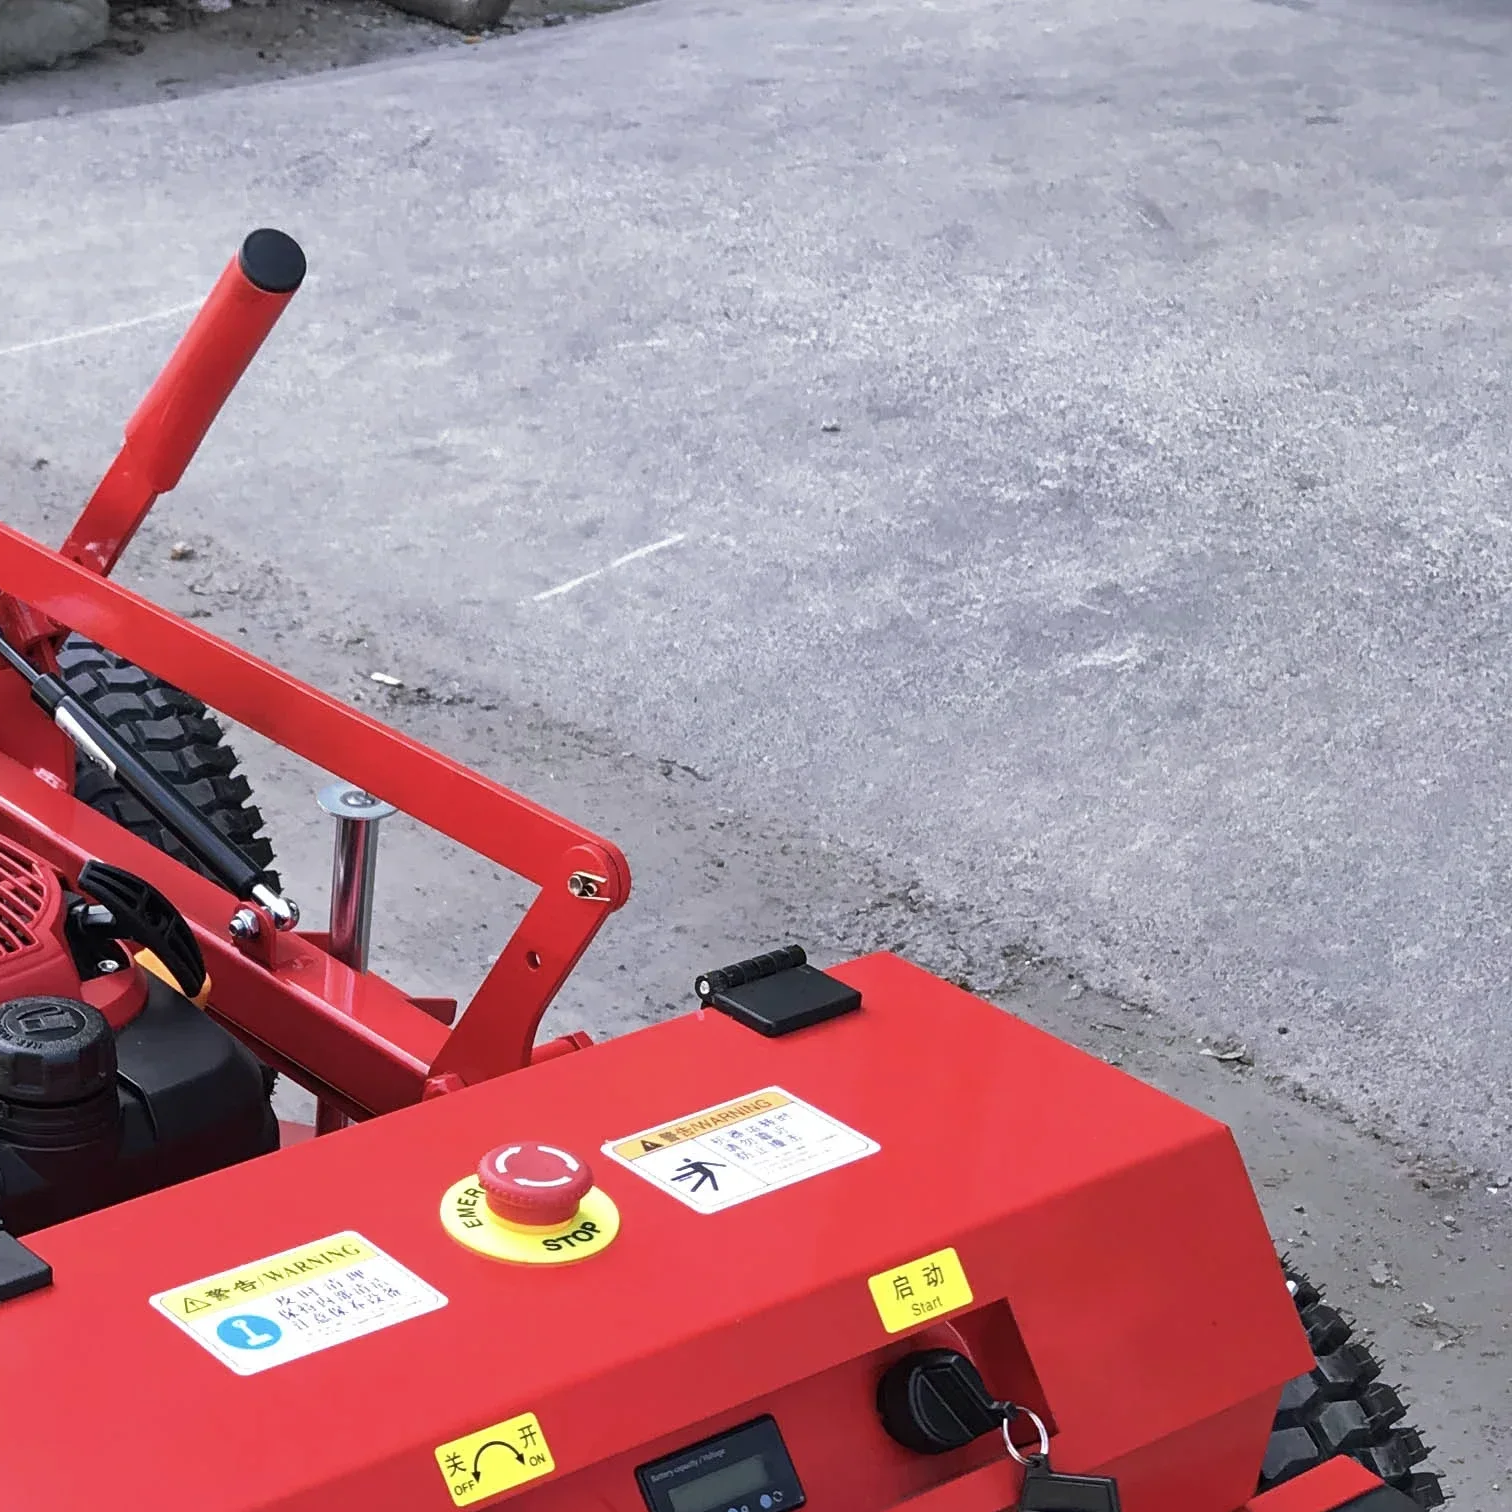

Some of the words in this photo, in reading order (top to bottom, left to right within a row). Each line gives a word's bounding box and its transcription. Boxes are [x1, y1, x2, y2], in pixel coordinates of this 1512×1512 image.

[541, 1221, 601, 1252] STOP
[892, 1262, 945, 1301] 启动
[911, 1295, 944, 1317] Start
[517, 1424, 537, 1449] 开
[444, 1451, 467, 1478] 关
[528, 1453, 547, 1467] ON
[453, 1479, 476, 1496] OFF
